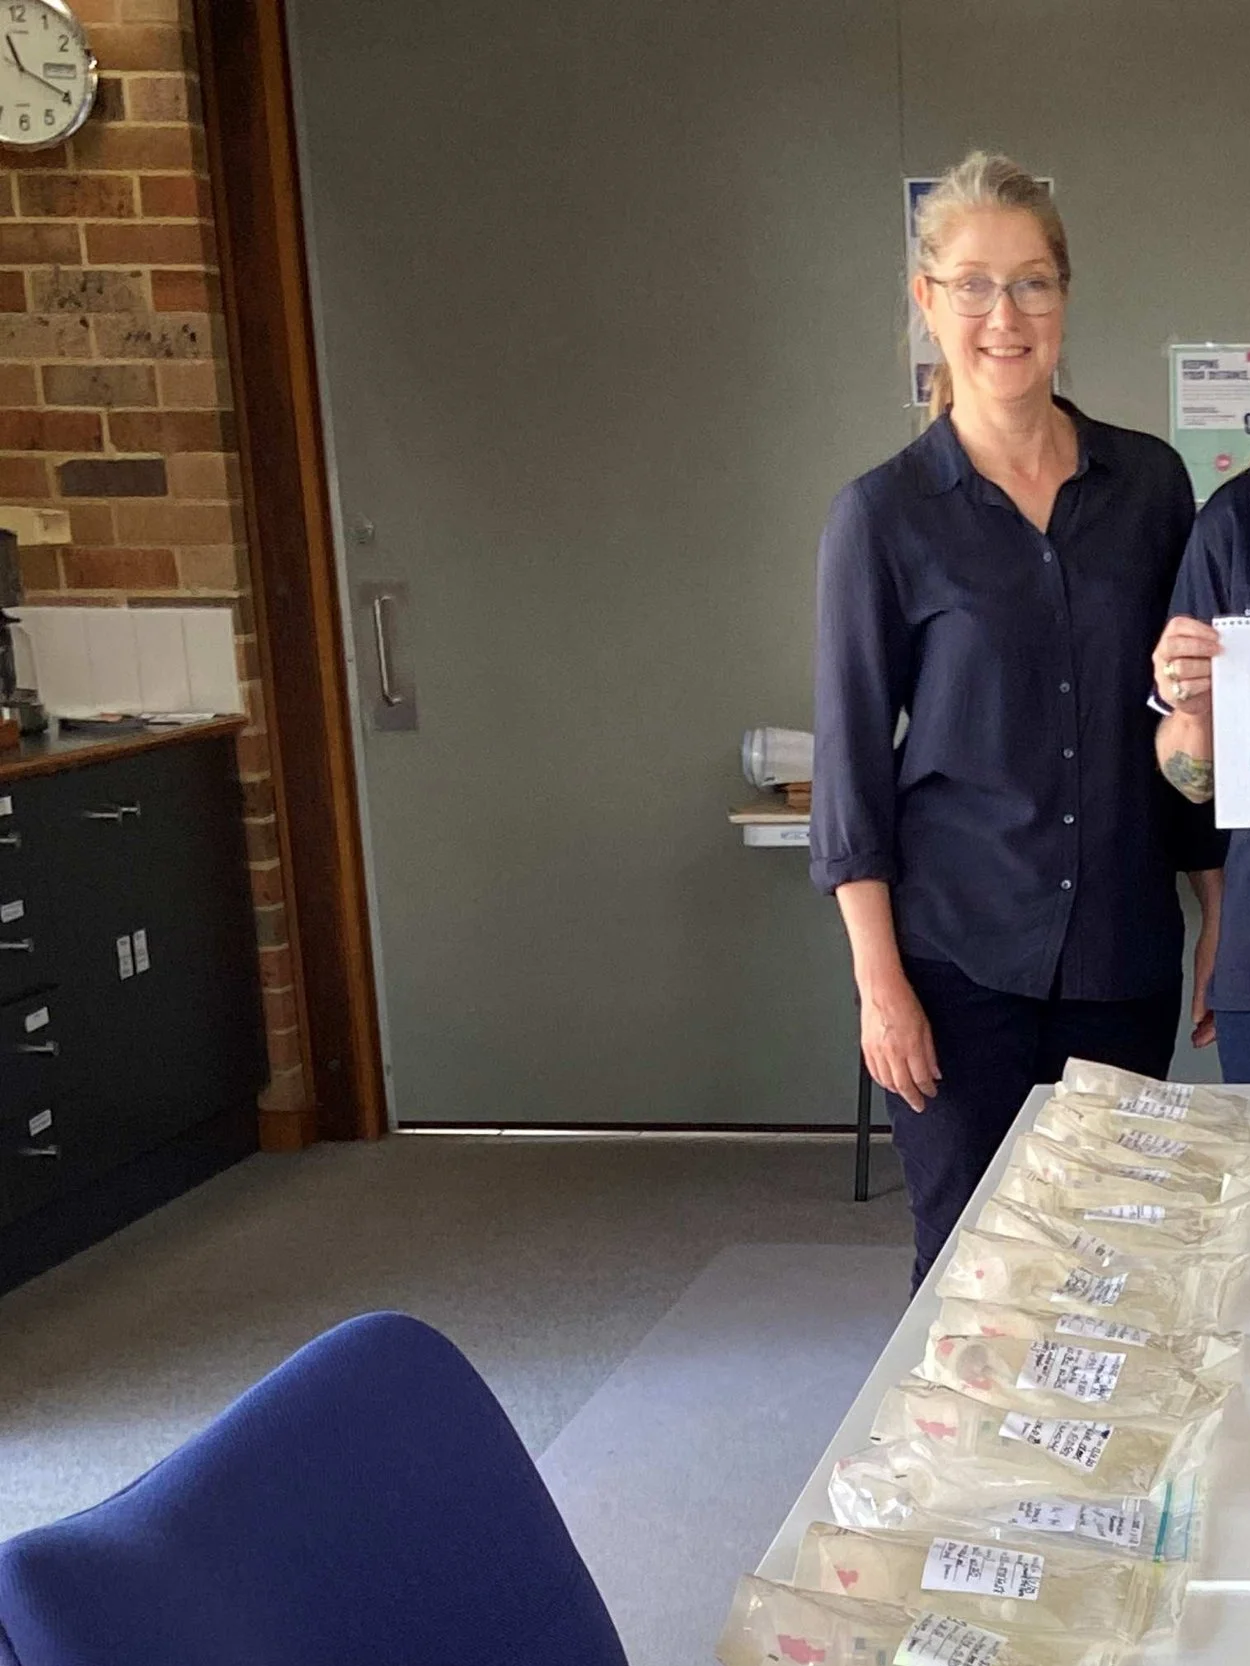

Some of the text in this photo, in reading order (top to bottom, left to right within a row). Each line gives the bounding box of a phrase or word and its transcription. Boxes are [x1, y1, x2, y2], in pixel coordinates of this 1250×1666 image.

[9, 5, 26, 23] 12
[41, 14, 49, 30] 1
[58, 35, 69, 52] 2
[19, 114, 30, 131] 6
[44, 109, 55, 125] 5
